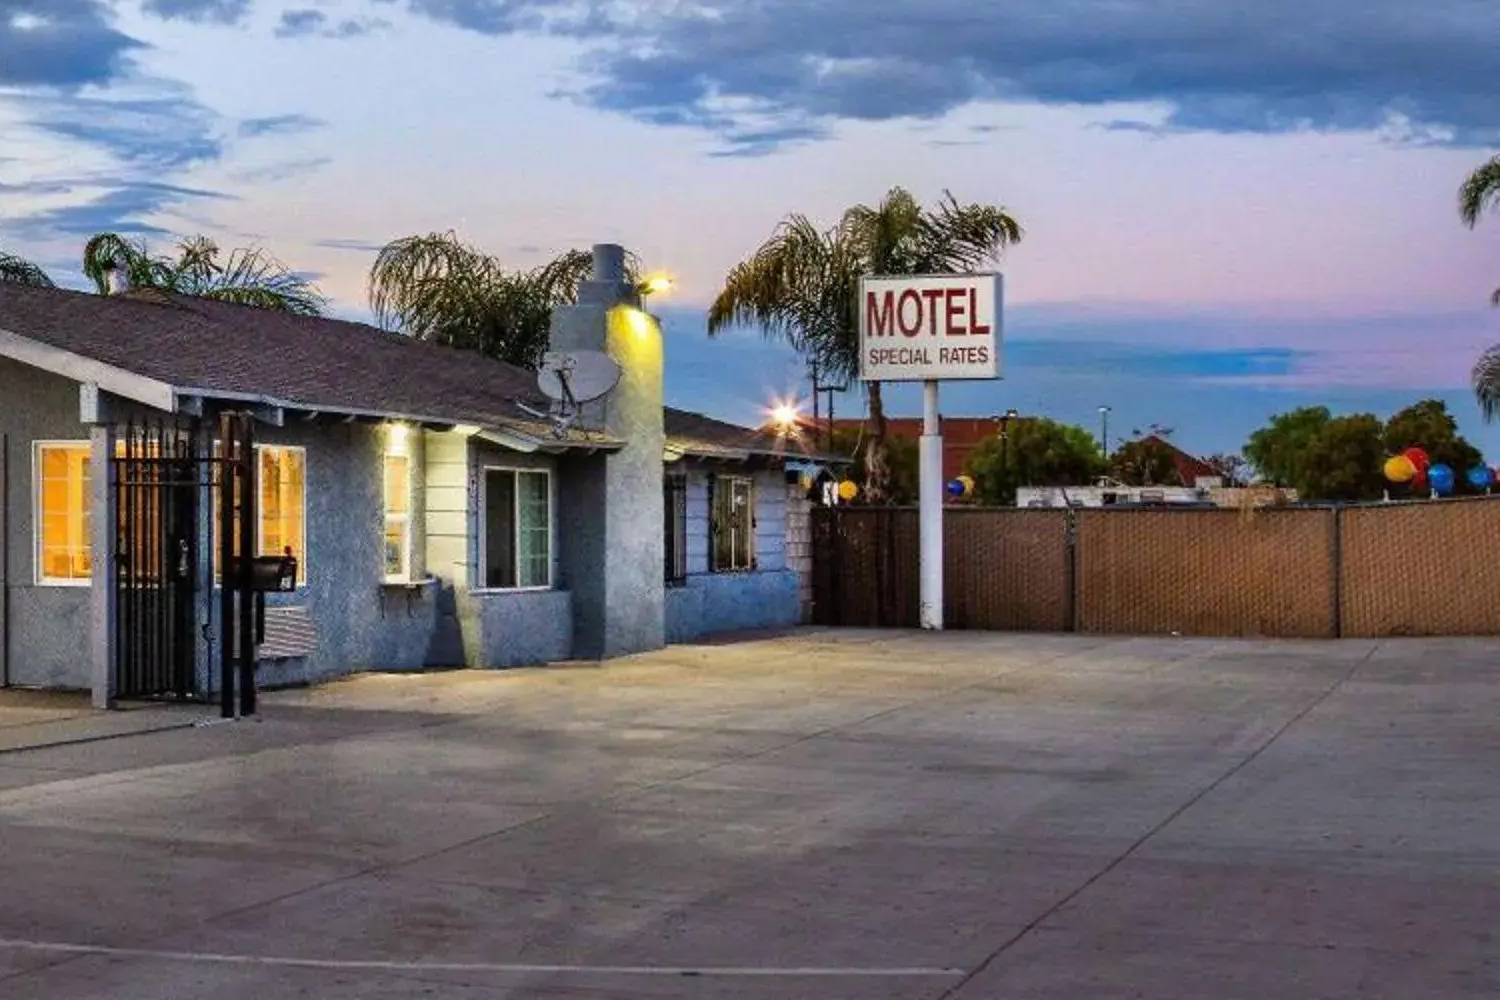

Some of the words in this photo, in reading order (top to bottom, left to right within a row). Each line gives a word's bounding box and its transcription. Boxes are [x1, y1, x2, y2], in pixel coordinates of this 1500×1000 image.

[866, 287, 990, 338] MOTEL
[869, 347, 933, 365] SPECIAL
[939, 346, 989, 364] RATES
